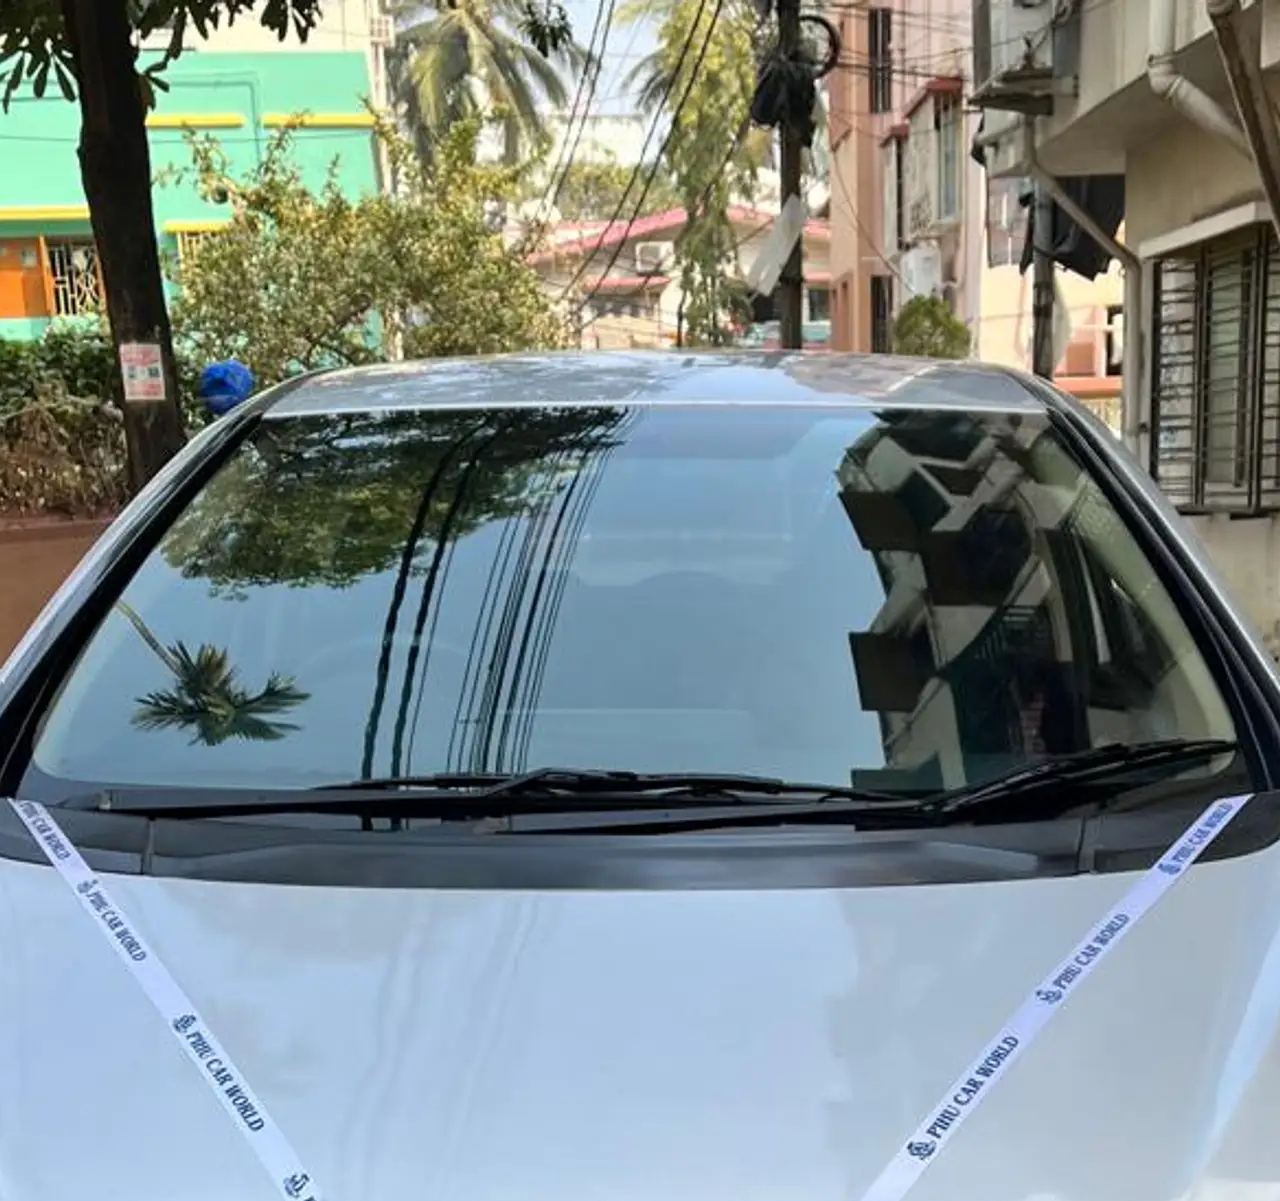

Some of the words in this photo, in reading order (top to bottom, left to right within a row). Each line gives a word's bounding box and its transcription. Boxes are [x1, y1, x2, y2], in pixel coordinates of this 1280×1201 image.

[1074, 944, 1102, 966] CAR
[1092, 913, 1130, 946] WORLD
[206, 1058, 234, 1086] CAR
[225, 1084, 265, 1132] WORLD
[953, 1078, 985, 1106] CAR
[975, 1036, 1019, 1078] WORLD
